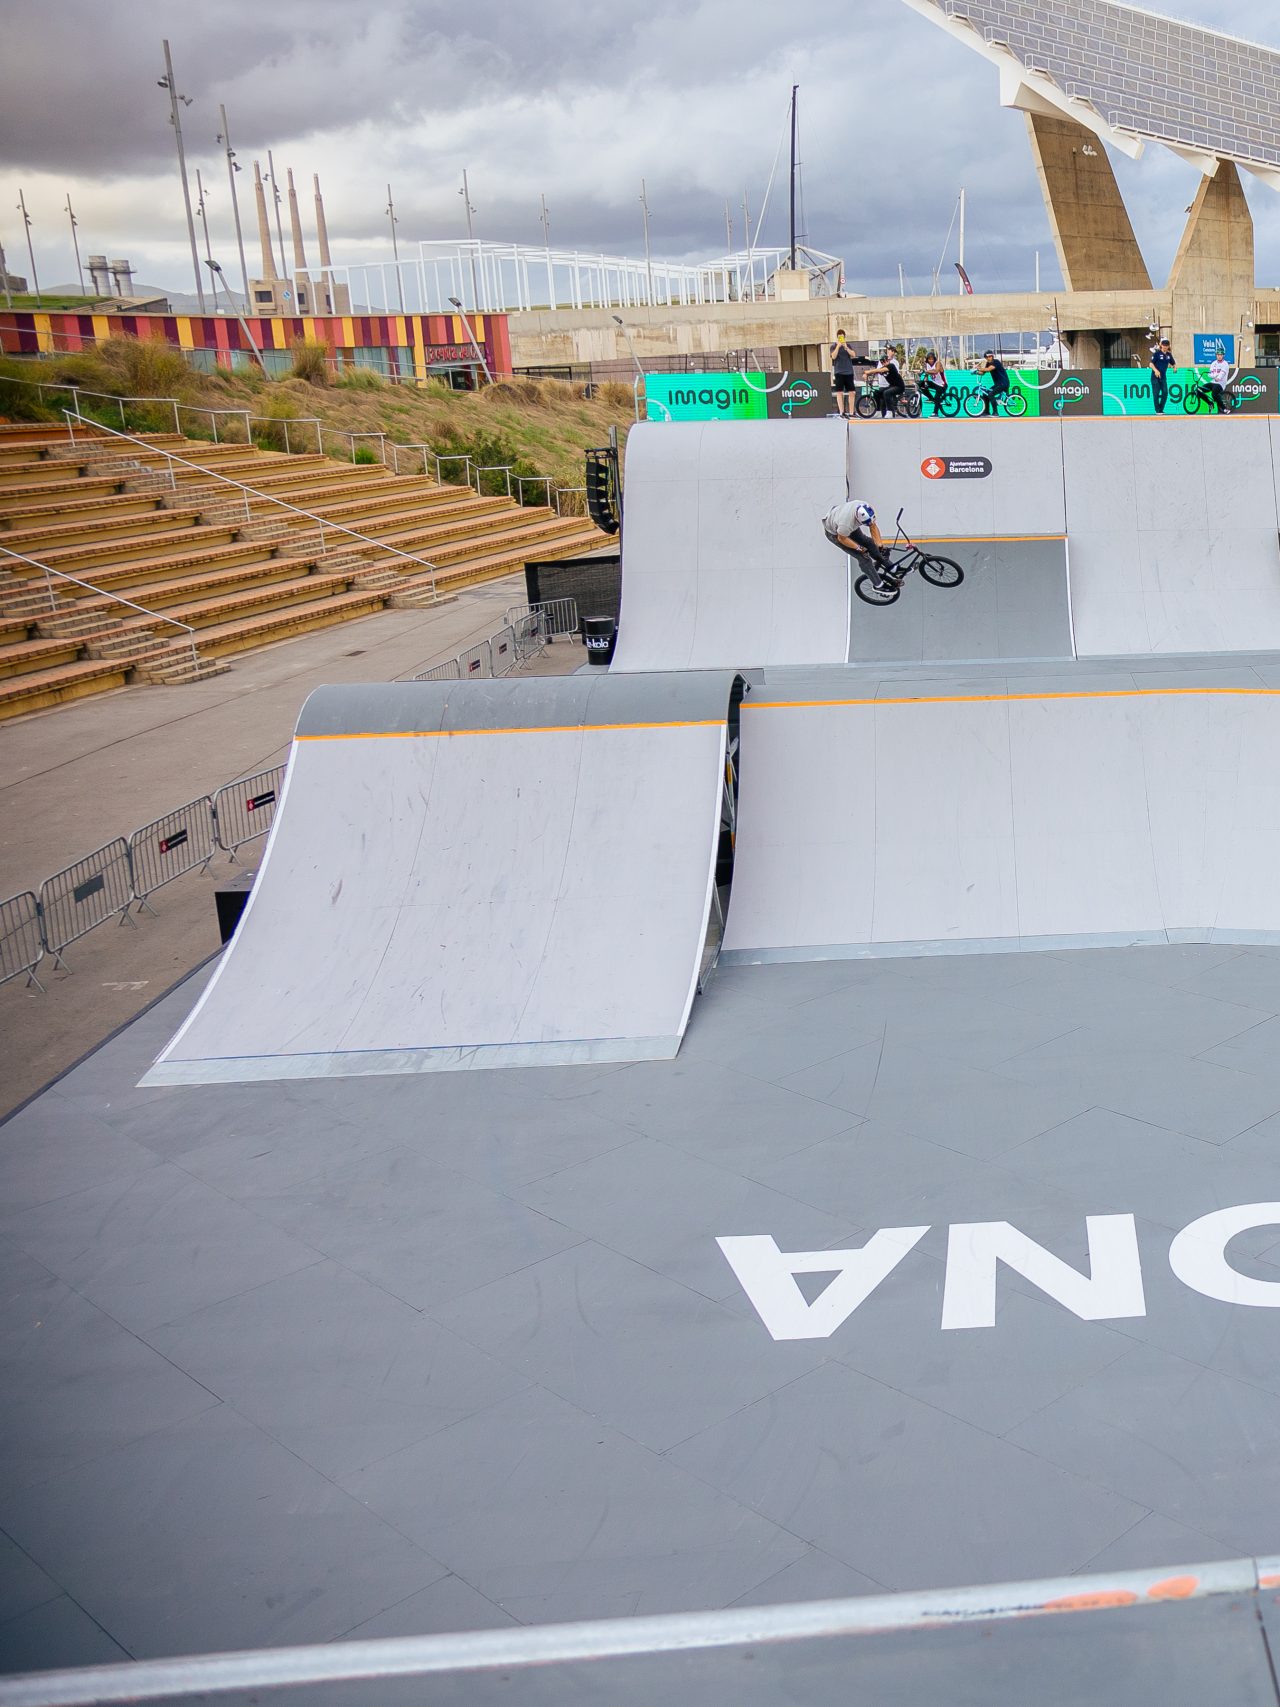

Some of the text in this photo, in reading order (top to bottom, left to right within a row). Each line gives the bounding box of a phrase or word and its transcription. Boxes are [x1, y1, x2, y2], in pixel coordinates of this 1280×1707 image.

[781, 388, 818, 400] imagin
[1054, 385, 1090, 397] imagin
[1232, 383, 1267, 395] imagin
[668, 389, 749, 409] imagin
